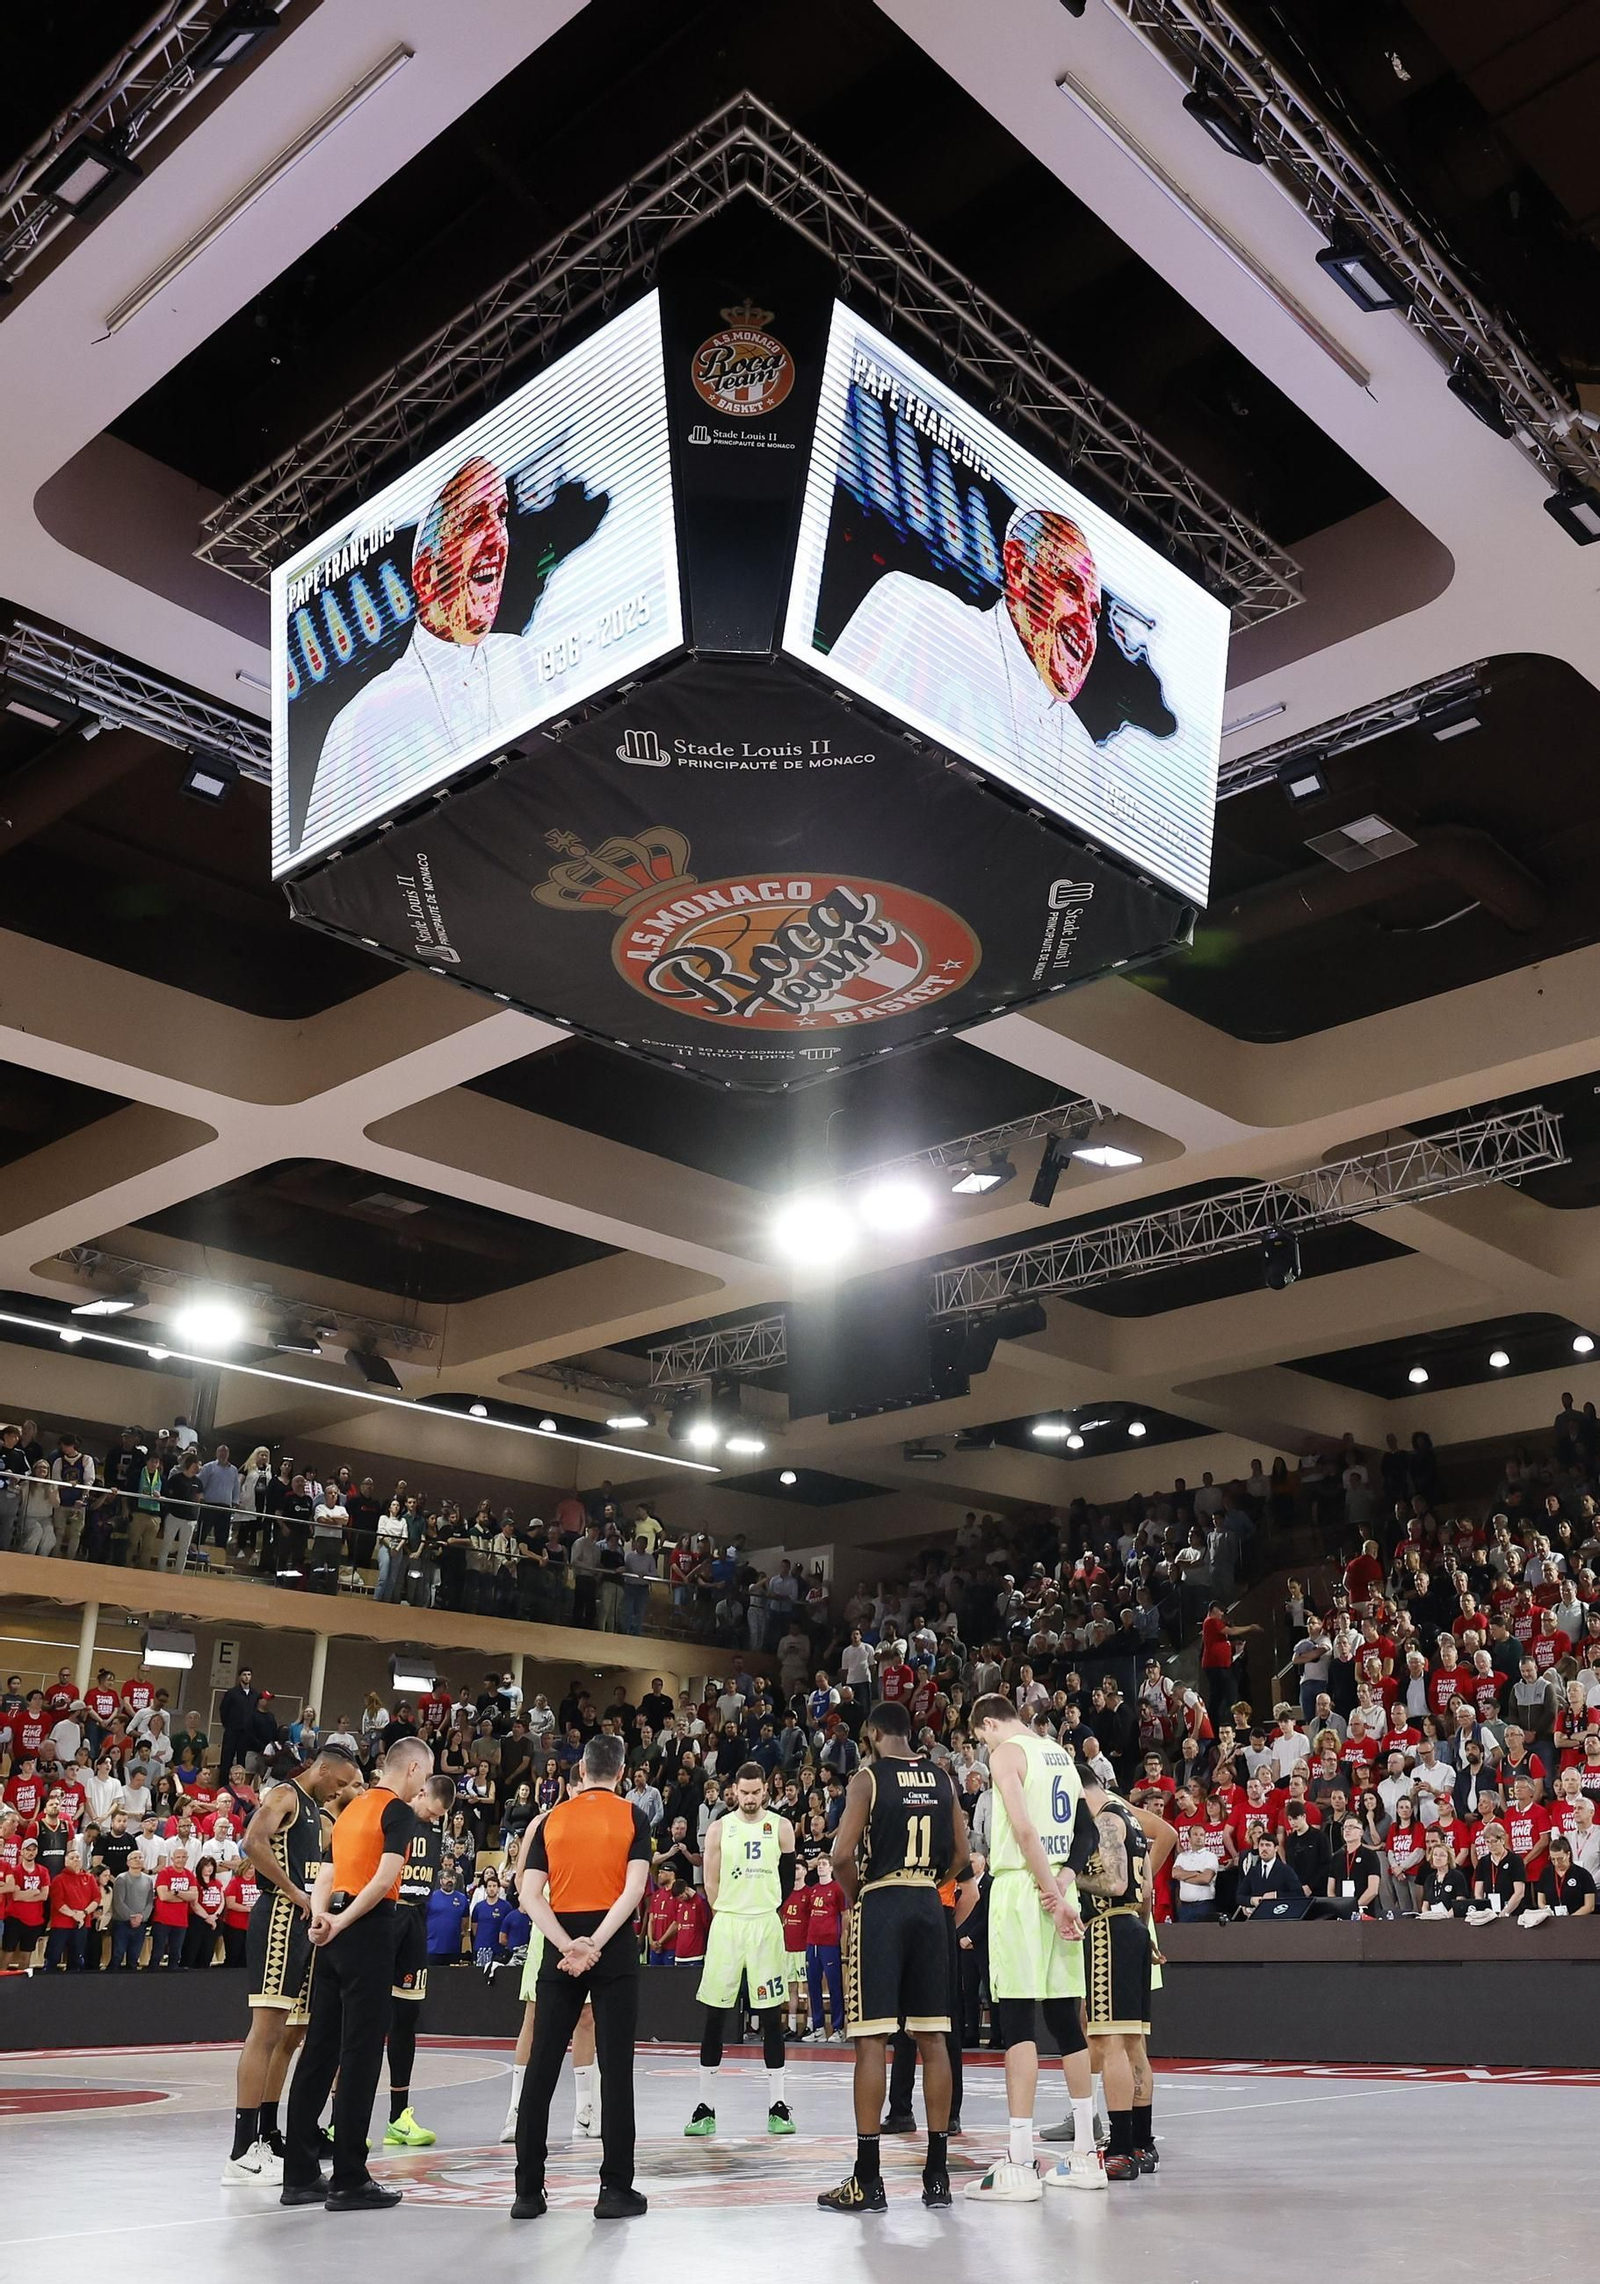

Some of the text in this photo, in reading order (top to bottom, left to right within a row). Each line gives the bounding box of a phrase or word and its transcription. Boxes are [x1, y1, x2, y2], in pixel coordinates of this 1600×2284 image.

[714, 332, 781, 354] A.S.MONACO
[698, 345, 786, 379] Roca
[703, 370, 779, 394] Team
[854, 352, 899, 412] PAPE
[717, 402, 764, 414] BASKET
[712, 430, 777, 441] Stade Louis II
[713, 439, 754, 448] PRINCIPAUTÉ
[288, 518, 394, 611] PAPE FRANÇOIS
[536, 640, 580, 686] 1936
[598, 593, 652, 648] 2025
[674, 738, 832, 758] Stade Louis II
[678, 754, 876, 770] PRINCIPAUTÉ DE MONACO
[416, 853, 434, 891] MONACO
[402, 890, 425, 920] Louis
[424, 892, 438, 904] DE
[410, 920, 434, 944] Stade
[627, 881, 812, 963] A.S.MONACO
[1062, 908, 1084, 936] Stade
[644, 885, 881, 1016] Roca
[1055, 937, 1077, 960] Louis
[734, 919, 900, 1018] Team
[831, 974, 956, 1024] BASKET
[816, 1560, 824, 1582] N
[220, 1642, 234, 1664] E
[1437, 1683, 1456, 1692] KING
[896, 1772, 936, 1788] DIALLO
[1052, 1775, 1072, 1824] 6
[1512, 1825, 1533, 1836] KING
[411, 1836, 427, 1858] 10
[744, 1841, 761, 1859] 13
[904, 1816, 931, 1868] 11
[787, 1905, 797, 1915] 45
[814, 1897, 824, 1907] 46
[414, 1968, 427, 1990] 10
[766, 1976, 784, 1998] 13
